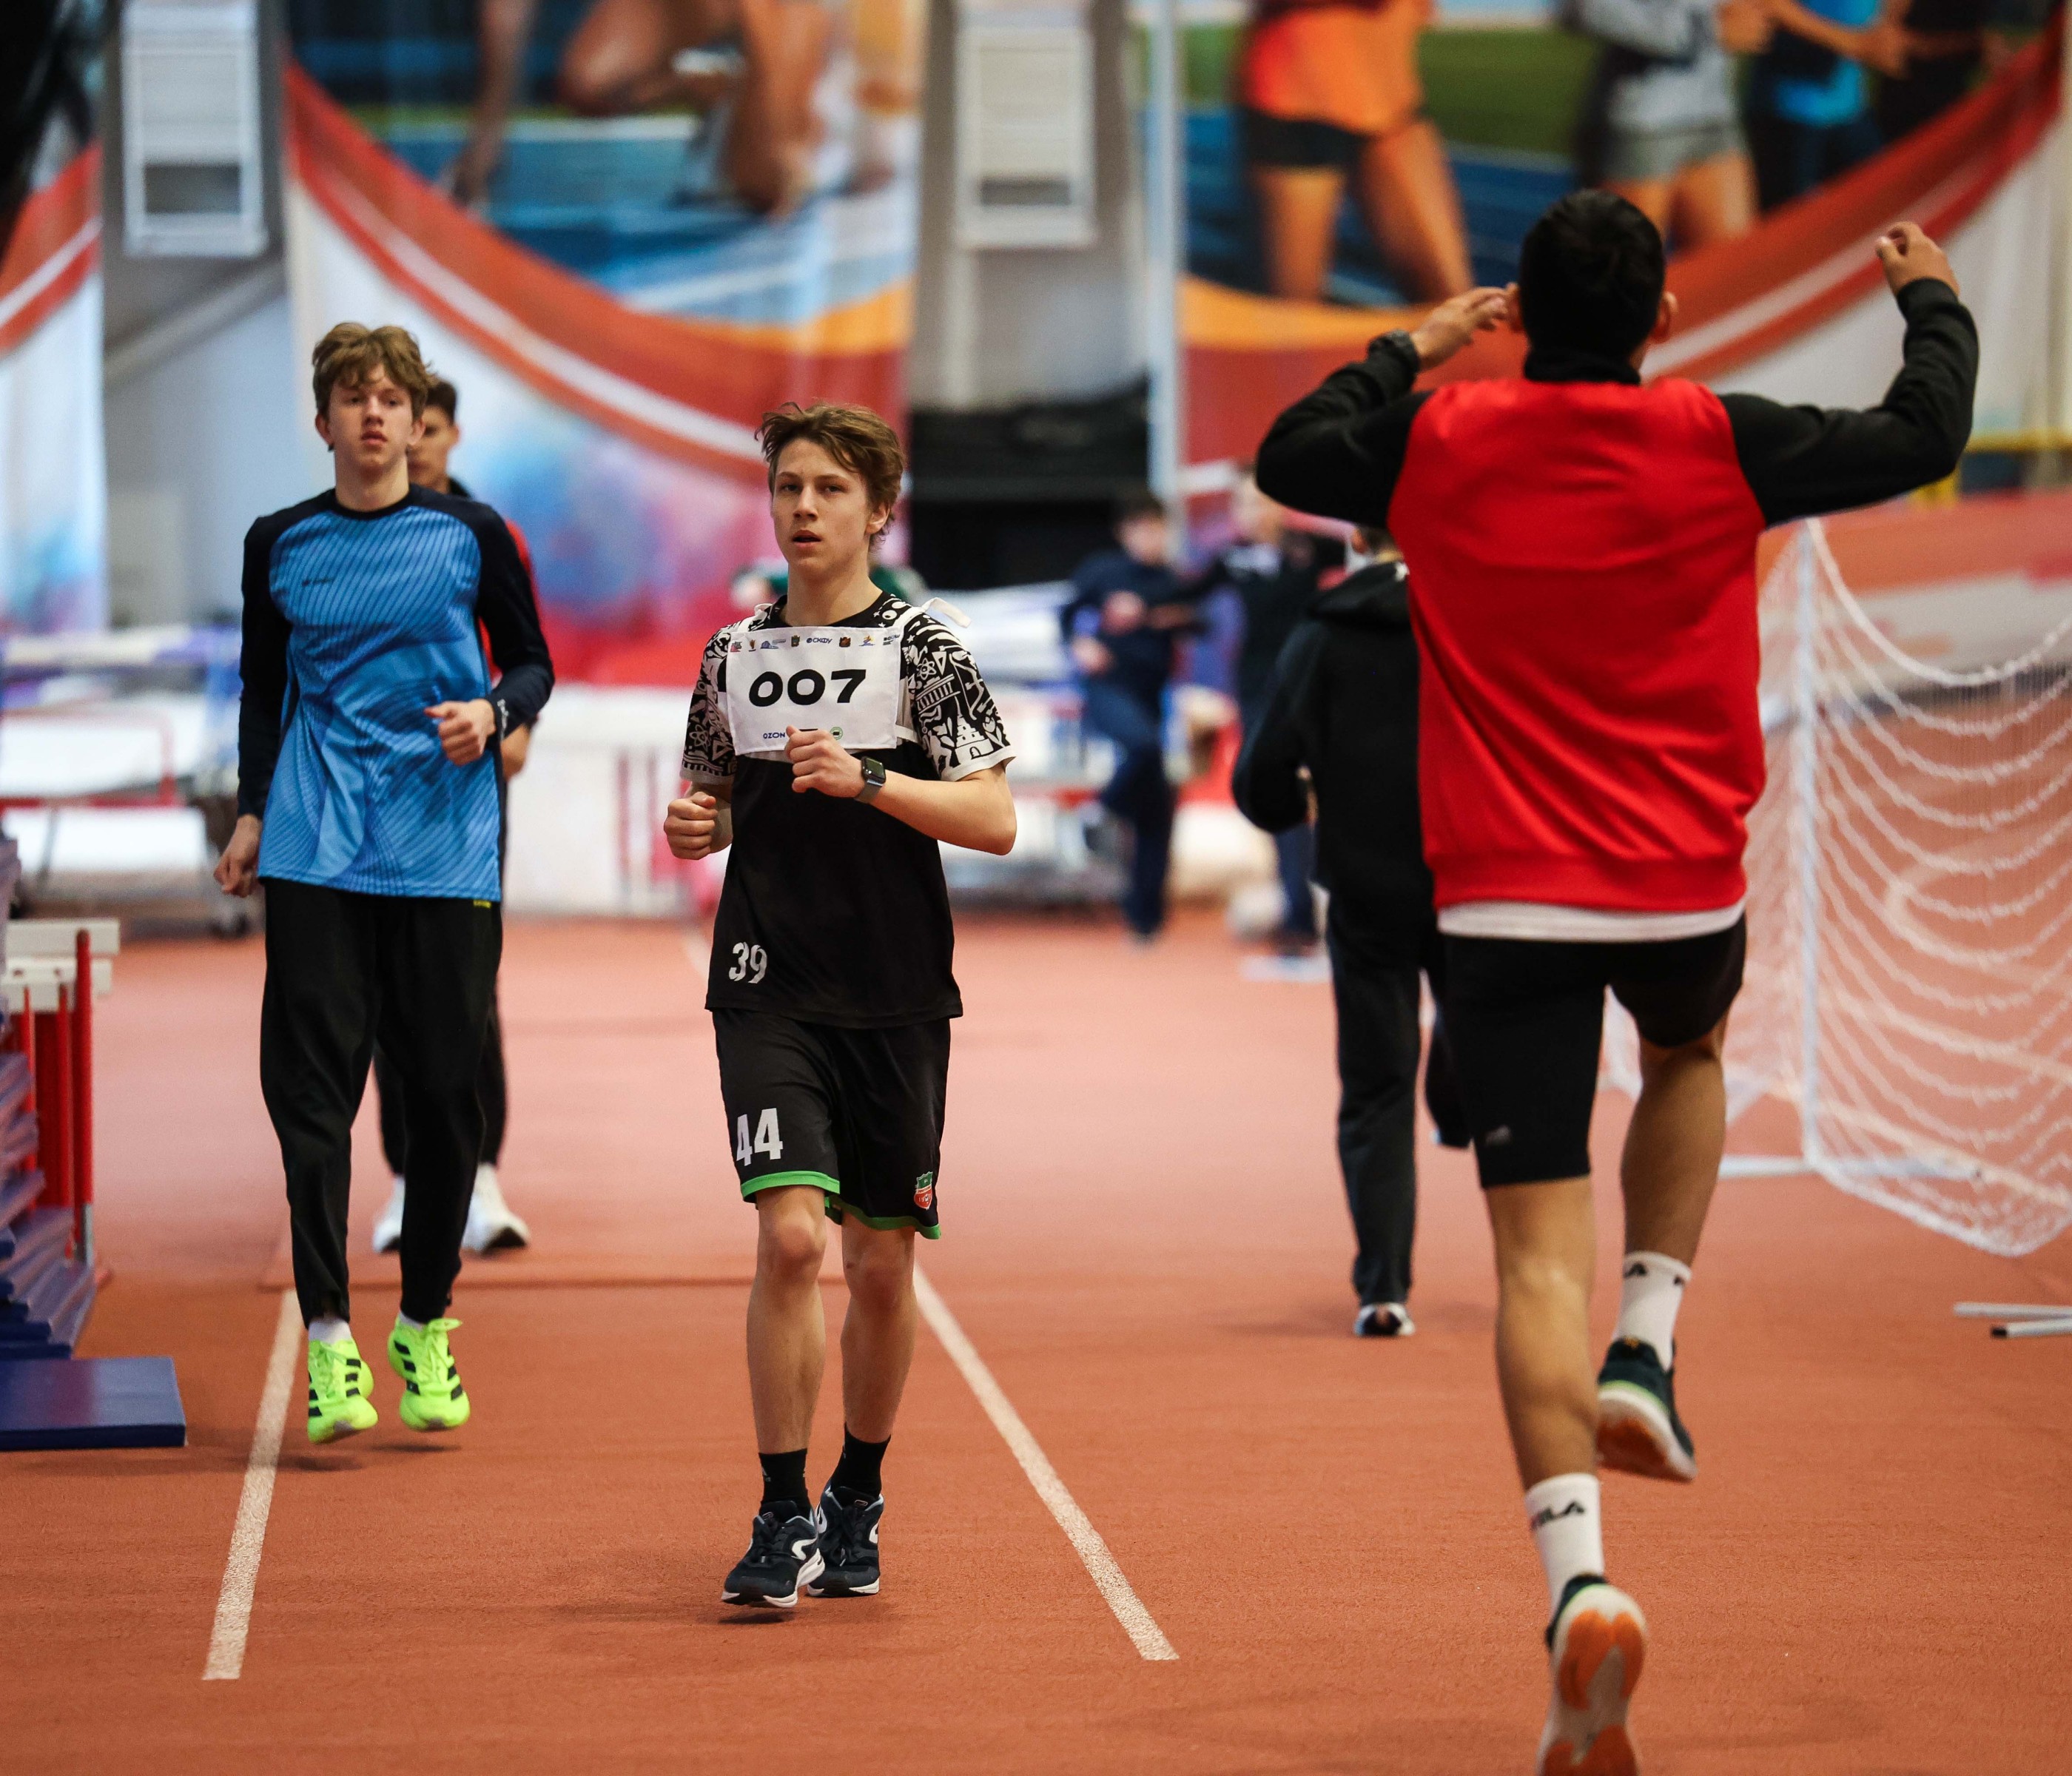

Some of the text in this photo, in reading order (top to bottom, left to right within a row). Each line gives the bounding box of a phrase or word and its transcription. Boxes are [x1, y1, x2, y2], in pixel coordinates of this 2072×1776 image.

[749, 669, 867, 707] 007
[728, 941, 767, 984] 39
[736, 1107, 784, 1167] 44
